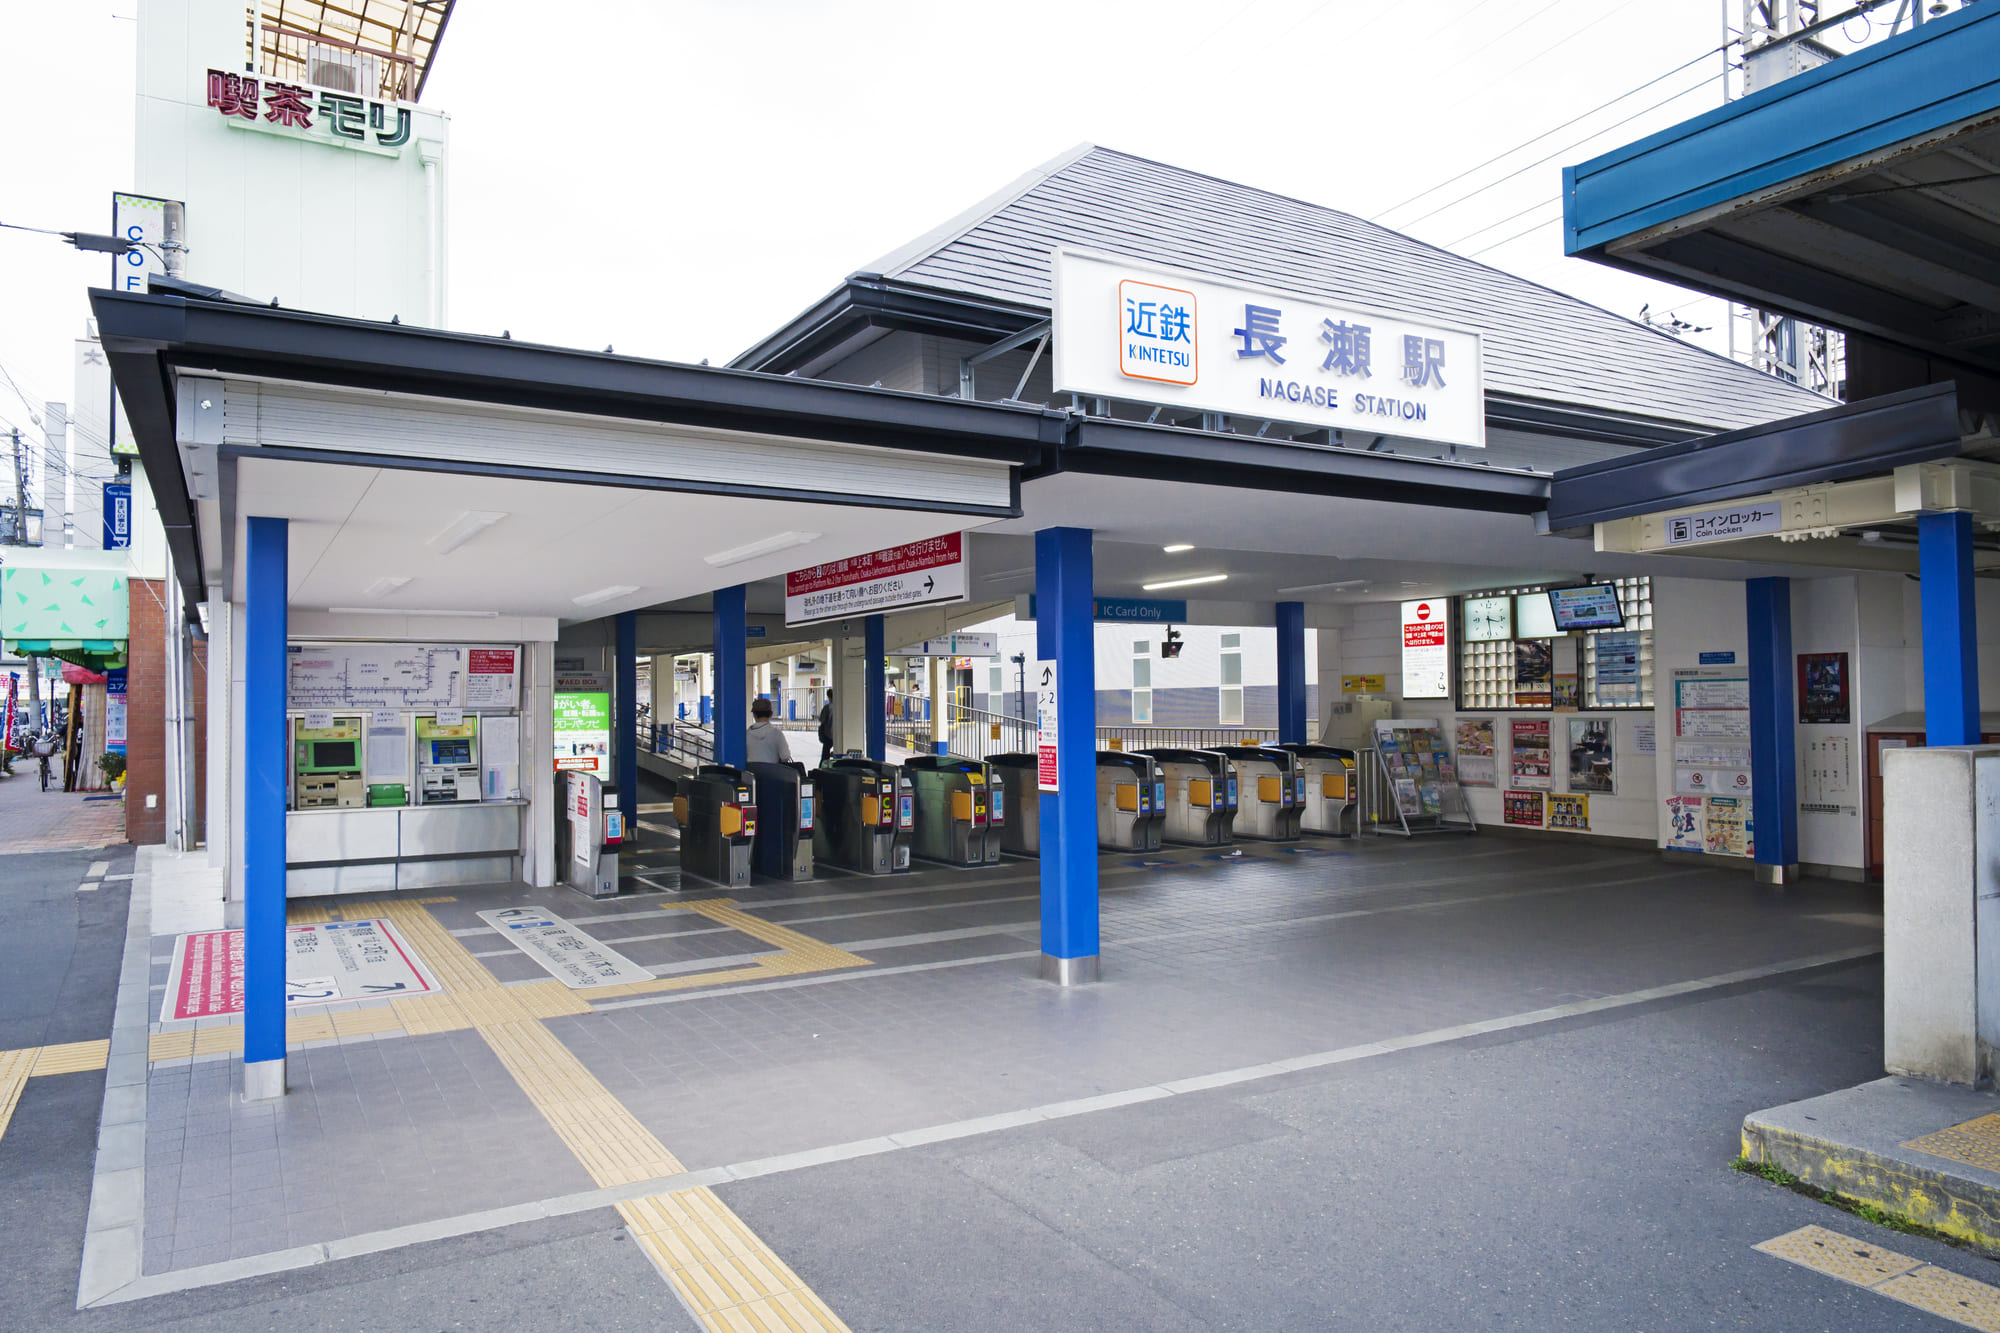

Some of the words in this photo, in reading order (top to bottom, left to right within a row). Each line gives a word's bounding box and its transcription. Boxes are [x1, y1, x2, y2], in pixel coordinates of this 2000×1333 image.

[207, 68, 410, 146] 喫茶モリ
[1127, 298, 1191, 345] 近鉄
[1234, 303, 1447, 388] 長瀬駅
[1129, 344, 1190, 368] KINTETSU
[1260, 377, 1339, 409] NAGASE
[1354, 392, 1427, 421] STATION
[1695, 510, 1774, 529] コインロッカー
[1695, 530, 1713, 538] Coin
[1714, 526, 1743, 536] Lockers
[1104, 606, 1113, 616] IC
[1115, 607, 1137, 617] Card
[1140, 607, 1161, 620] Only
[1440, 672, 1444, 680] 2
[1049, 692, 1054, 704] 2
[287, 989, 334, 1001] 2
